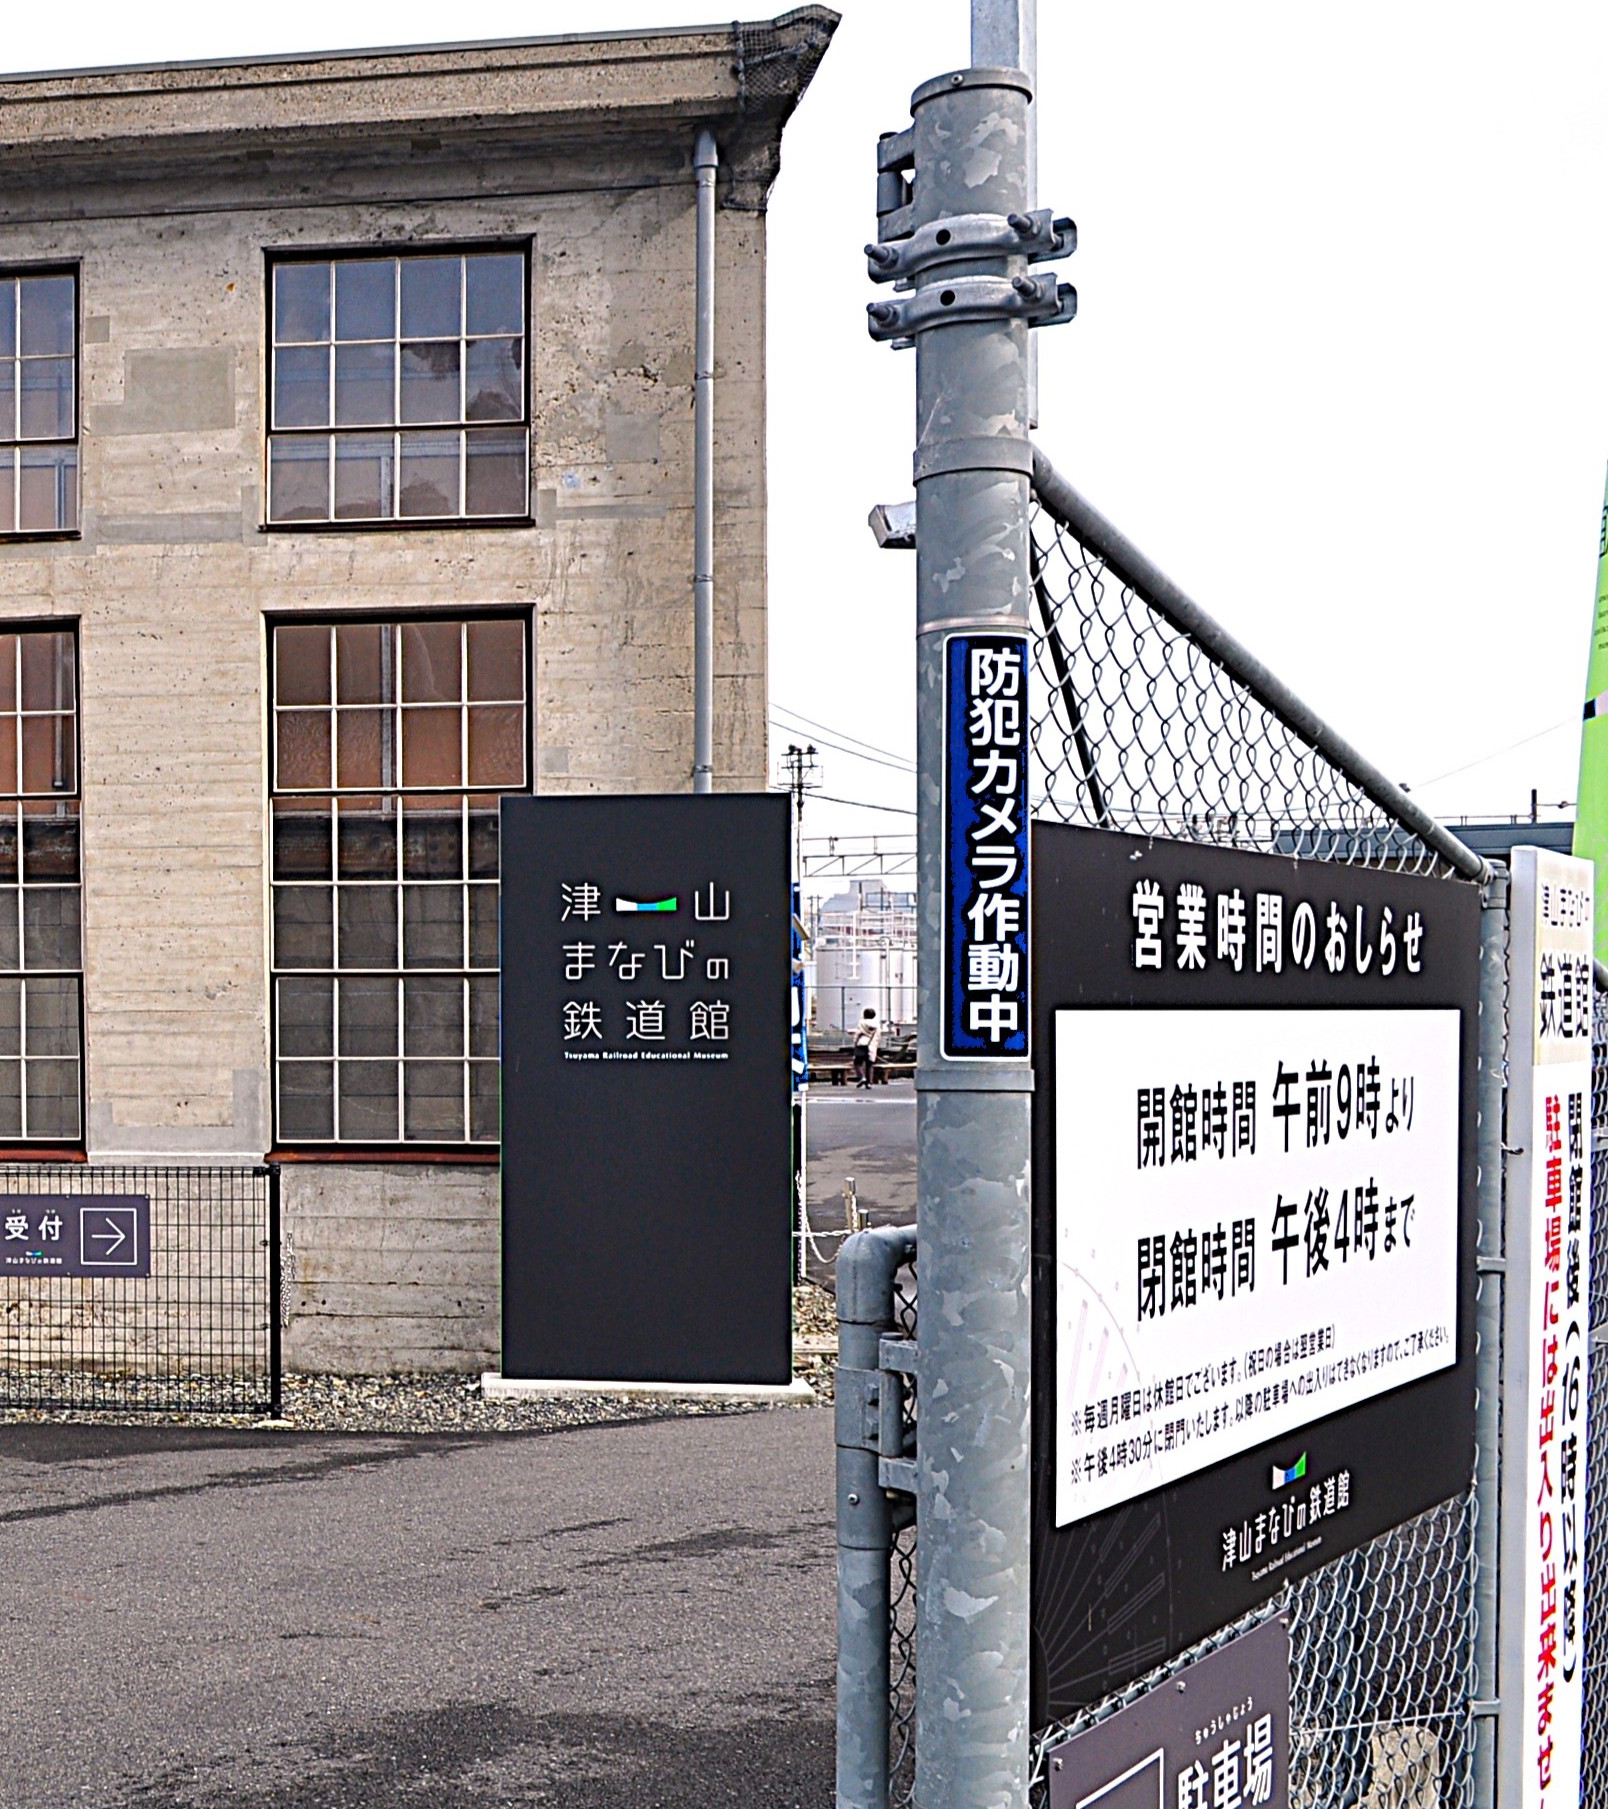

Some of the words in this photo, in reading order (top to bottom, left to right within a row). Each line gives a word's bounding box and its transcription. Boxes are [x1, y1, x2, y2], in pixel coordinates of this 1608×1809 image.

[968, 647, 1022, 1043] 防犯カメラ作動中
[562, 939, 730, 980] まなびの
[1132, 879, 1424, 976] 営業時間のおしらせ
[562, 1000, 730, 1041] 鉄道館
[1539, 953, 1590, 1039] 鉄道館
[564, 1051, 600, 1061] Tsuyama
[602, 1051, 638, 1060] Railroad
[641, 1051, 691, 1060] Educational
[693, 1051, 729, 1060] Museum
[1136, 1079, 1257, 1170] 開館時間
[1271, 1055, 1415, 1153] 午前9時より
[5, 1215, 63, 1241] 受付
[1136, 1217, 1257, 1323] 閉館時間
[1271, 1177, 1416, 1286] 午後4時まで
[1537, 1095, 1563, 1809] 駐車場には出入り出来ませ
[1222, 1469, 1350, 1572] 津山まなびの鉄道館
[1178, 1713, 1273, 1809] 駐車場
